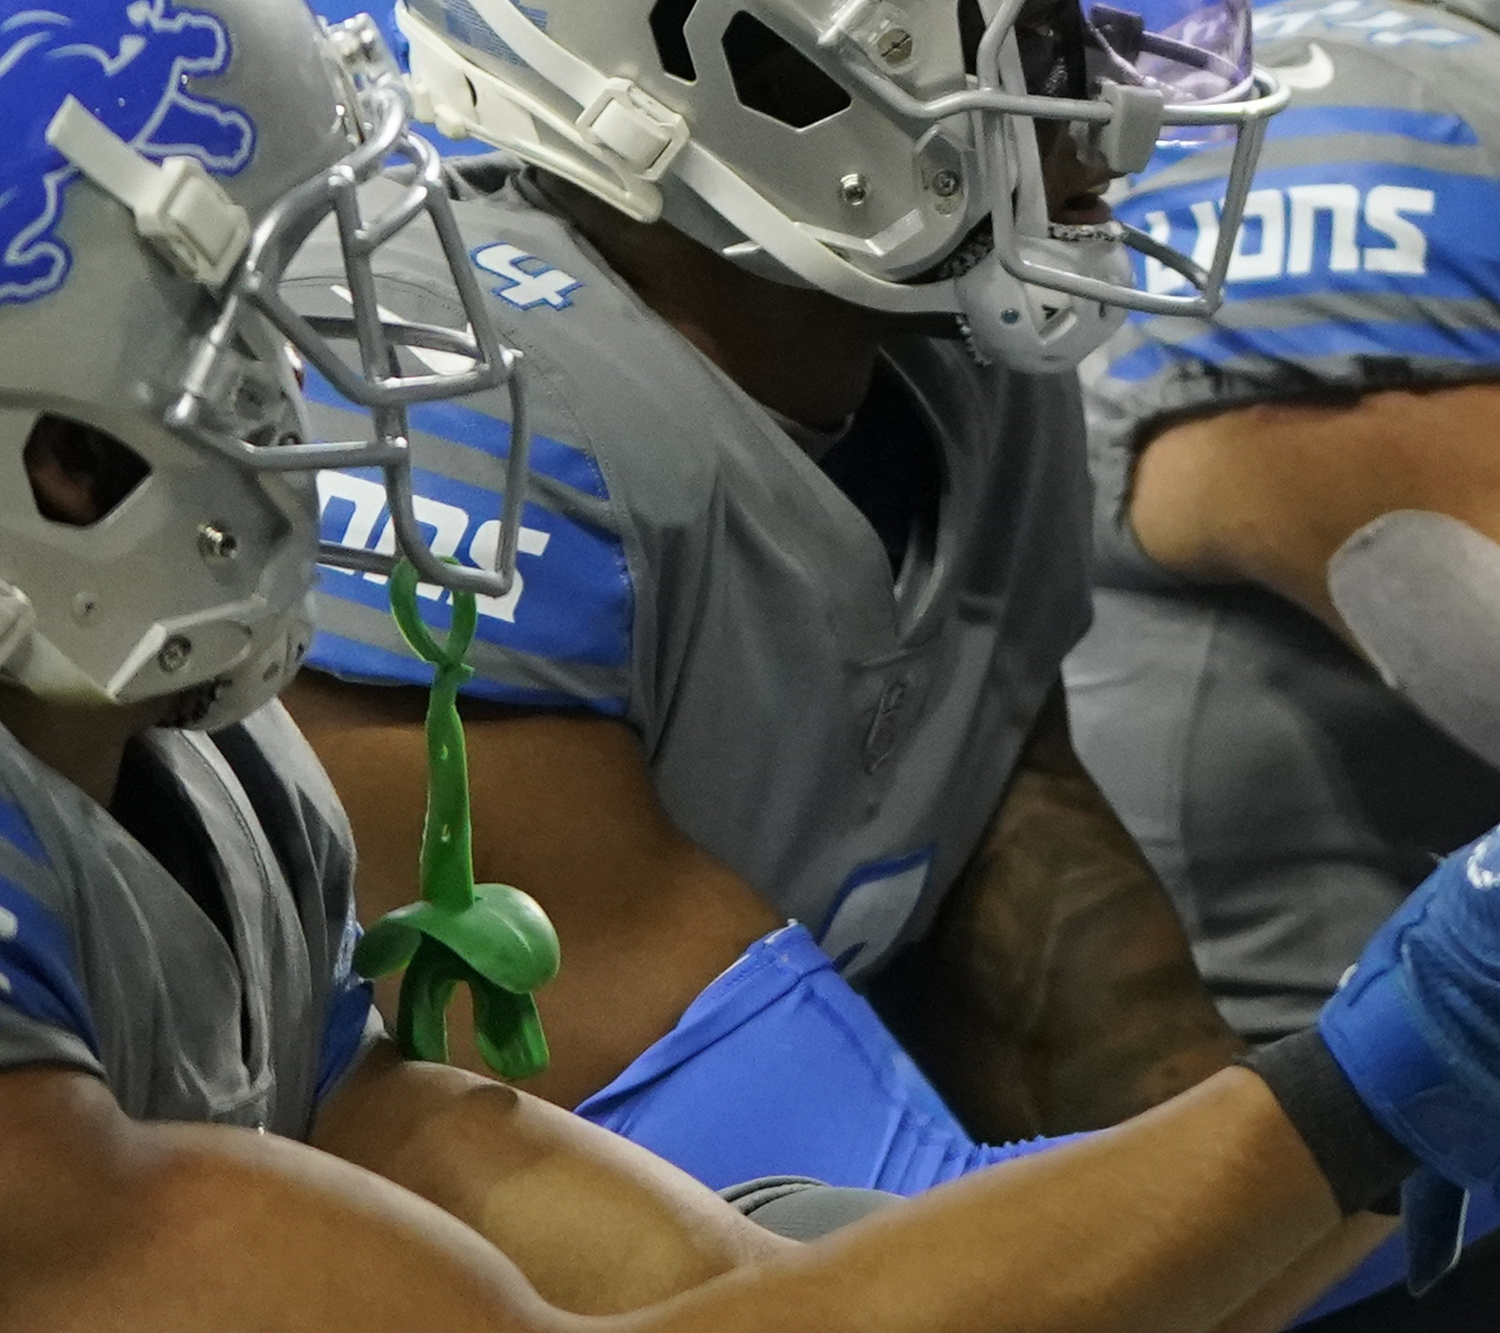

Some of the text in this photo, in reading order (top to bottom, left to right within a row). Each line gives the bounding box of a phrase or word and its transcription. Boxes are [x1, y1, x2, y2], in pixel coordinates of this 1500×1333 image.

[468, 241, 585, 312] 4
[1144, 183, 1437, 295] LIONS
[315, 468, 552, 624] ONS
